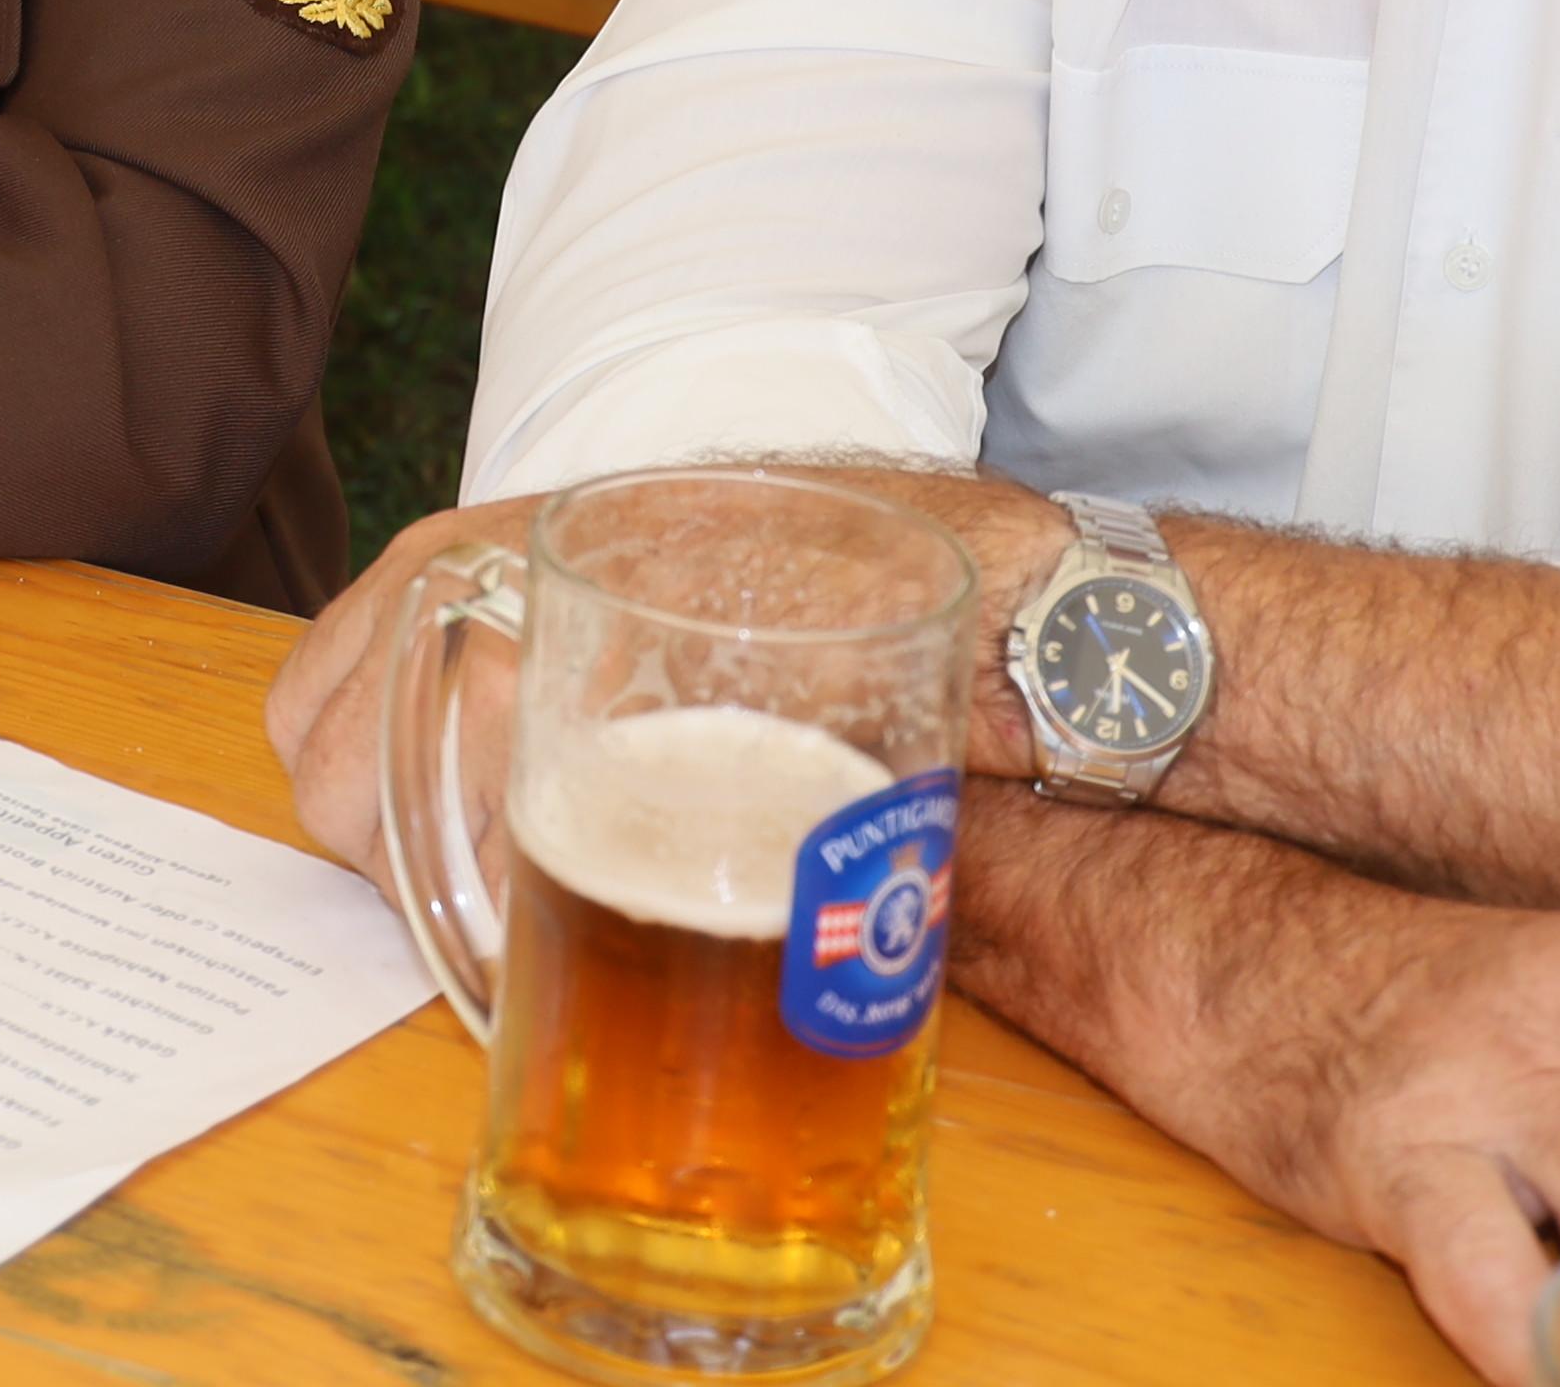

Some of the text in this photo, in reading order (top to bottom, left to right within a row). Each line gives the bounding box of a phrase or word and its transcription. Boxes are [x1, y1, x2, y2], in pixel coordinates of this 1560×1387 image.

[86, 844, 156, 877] Guten
[49, 865, 138, 904] Aufstrich
[141, 902, 189, 922] oder
[59, 939, 171, 984] Mehlspeise
[151, 938, 288, 998] Palatschinken
[222, 929, 325, 977] Eierspeise
[44, 967, 93, 991] Salat
[100, 988, 215, 1036] Gemischter
[175, 980, 251, 1017] Portion
[102, 1025, 177, 1059] Gebäck
